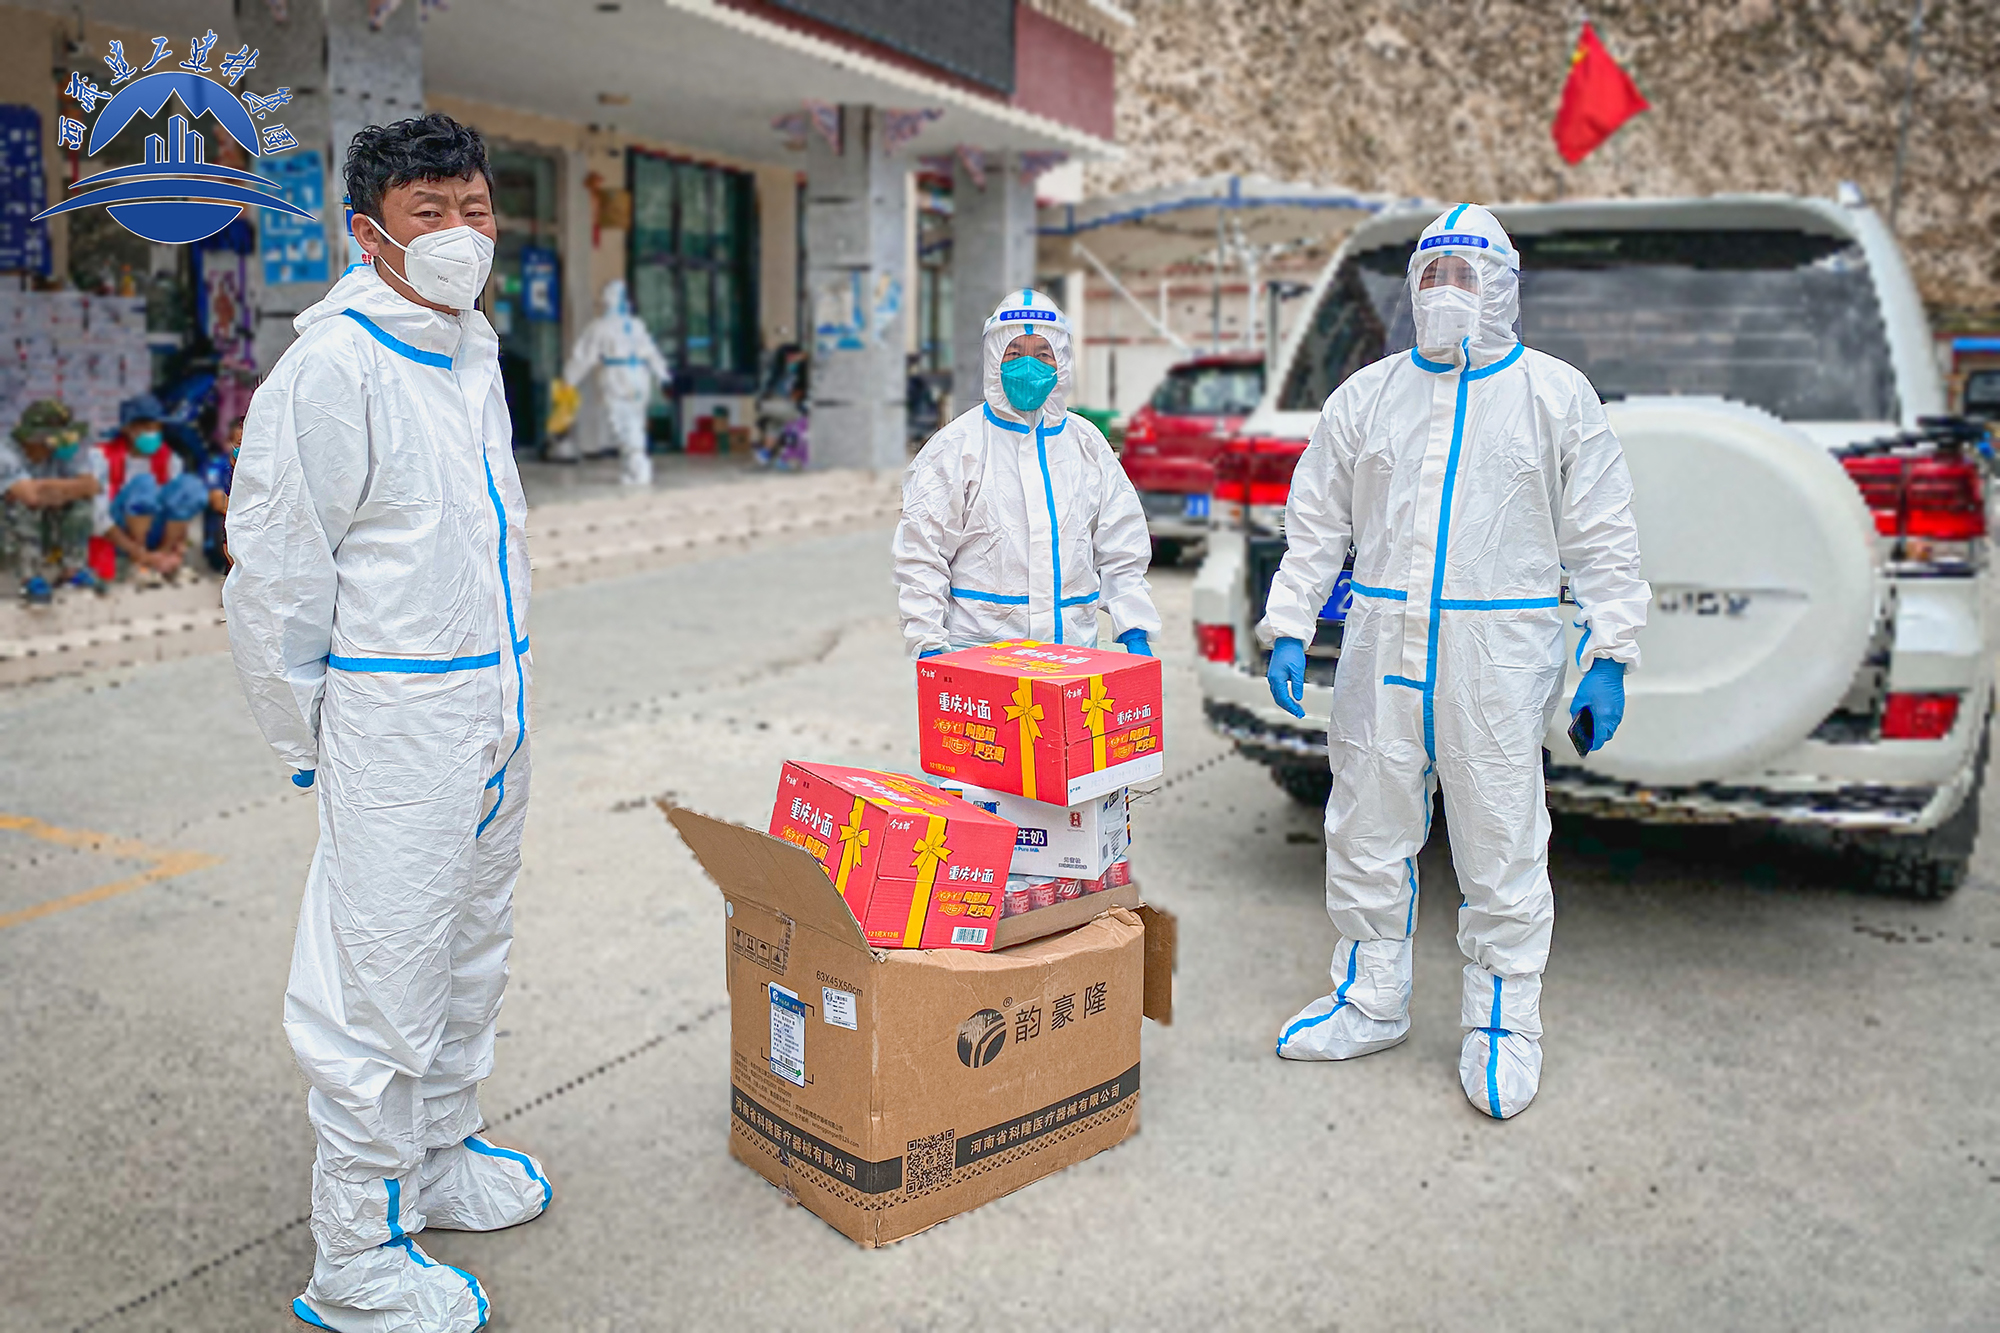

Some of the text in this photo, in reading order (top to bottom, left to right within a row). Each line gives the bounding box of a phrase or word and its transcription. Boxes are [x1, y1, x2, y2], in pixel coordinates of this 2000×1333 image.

[938, 691, 992, 721] 重庆小面
[1117, 704, 1152, 725] 重庆小面
[790, 796, 834, 839] 重庆小面
[1017, 829, 1045, 845] 牛奶
[948, 865, 994, 883] 重庆小面
[816, 970, 863, 998] 63X45X50cm
[1014, 981, 1108, 1044] 韵豪隆
[970, 1082, 1121, 1157] 河南省科隆医疗器械有限公司
[735, 1094, 857, 1182] 河南省科隆医疗器械有限公司
